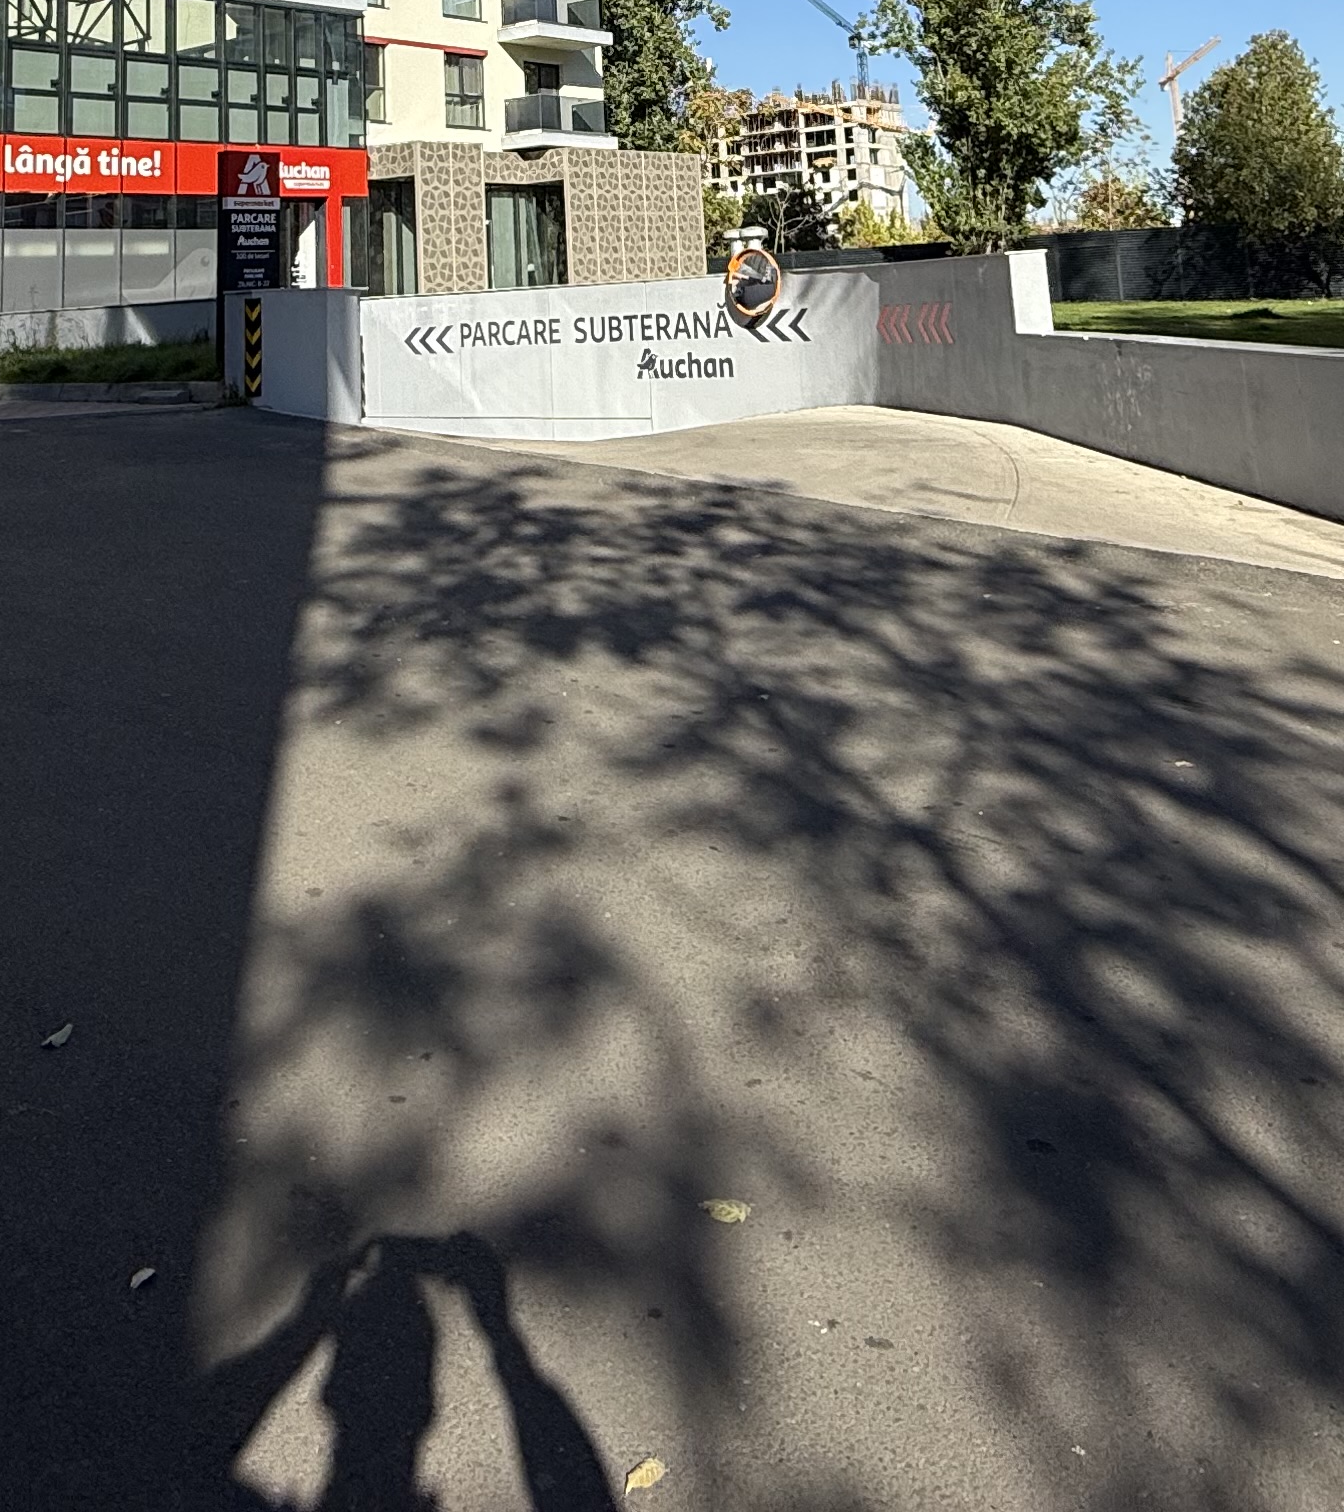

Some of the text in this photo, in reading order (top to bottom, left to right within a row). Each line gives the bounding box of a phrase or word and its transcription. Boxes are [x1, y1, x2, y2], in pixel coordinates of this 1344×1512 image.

[4, 144, 91, 182] lângă
[96, 147, 162, 177] tine!
[279, 161, 331, 179] uchan
[231, 213, 276, 224] PARCARE
[460, 302, 733, 348] PARCARE SUBTERANĂ
[636, 348, 734, 380] Auchan
